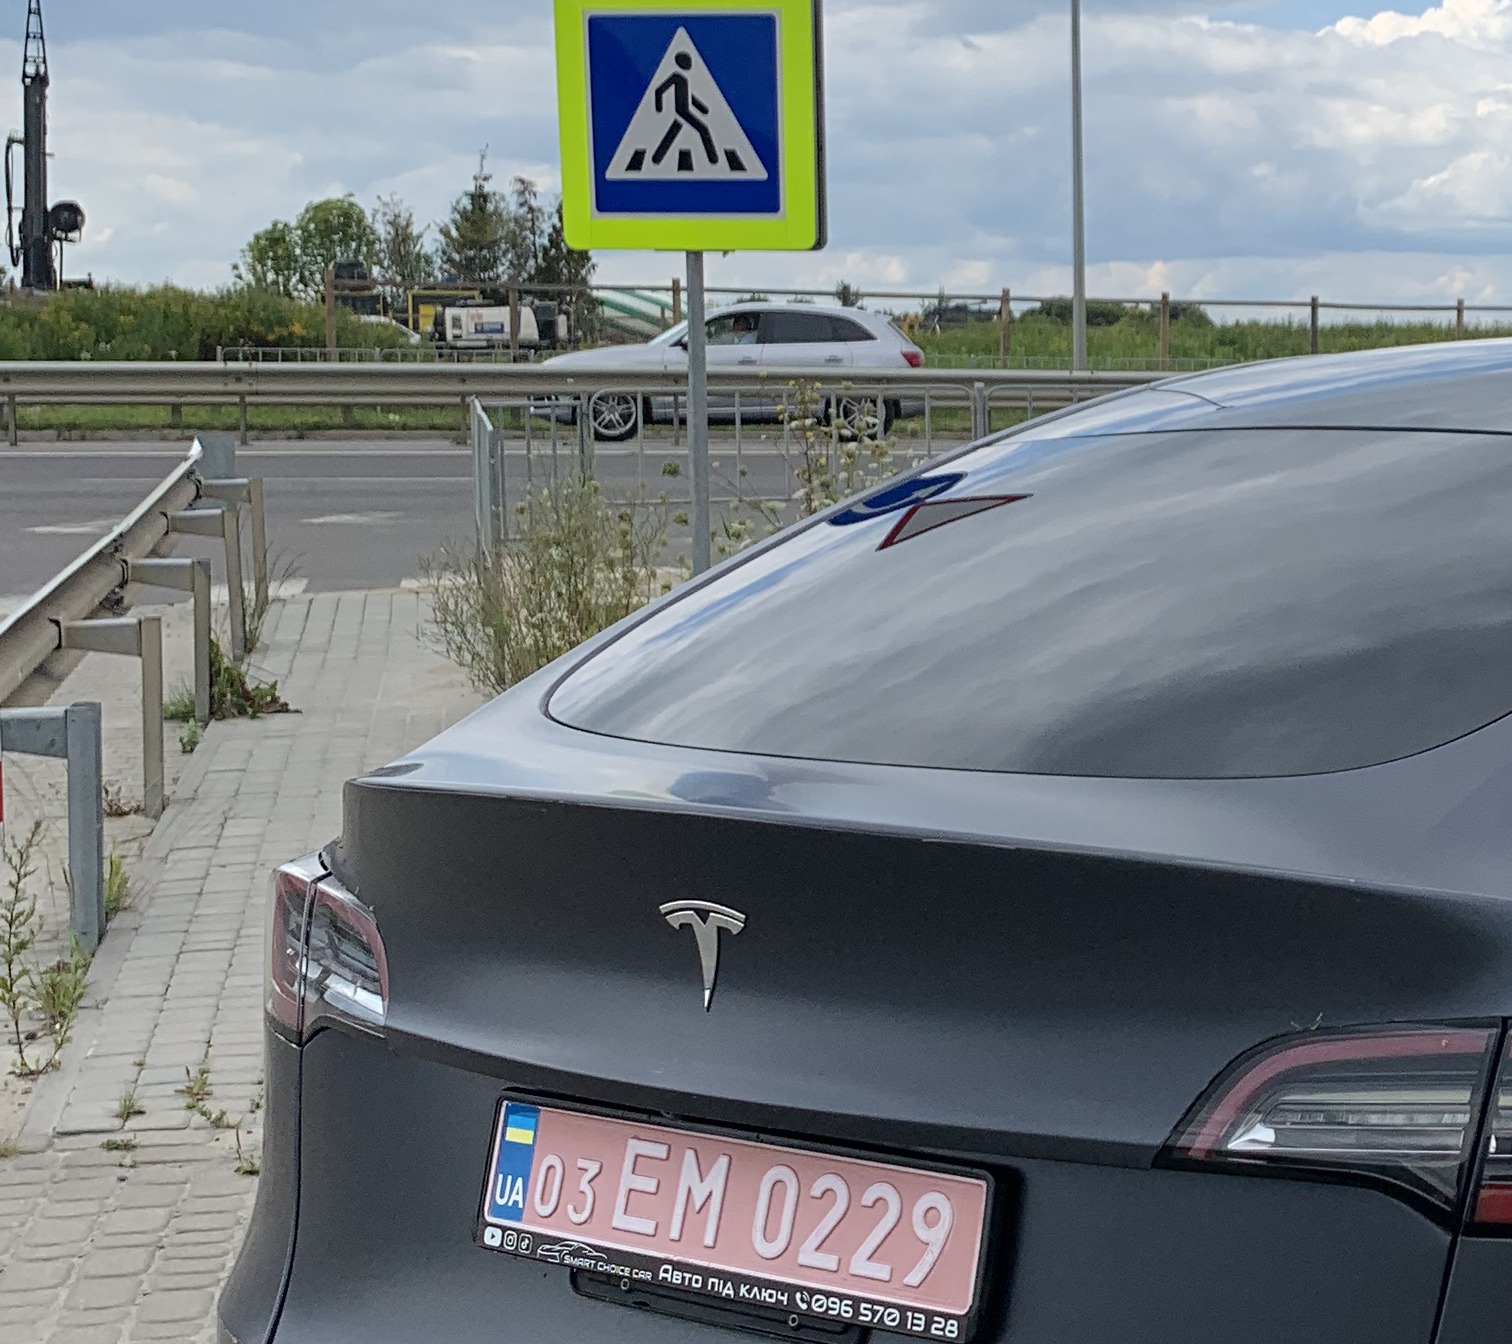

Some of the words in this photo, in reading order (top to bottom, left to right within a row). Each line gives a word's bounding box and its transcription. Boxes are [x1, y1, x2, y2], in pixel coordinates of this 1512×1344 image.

[495, 1173, 524, 1208] UA
[534, 1154, 602, 1226] 03
[611, 1136, 732, 1248] EM
[752, 1164, 954, 1288] 0229
[564, 1255, 597, 1269] SMART
[597, 1262, 631, 1277] CHOICE
[632, 1269, 652, 1281] CAR
[811, 1294, 853, 1318] 096
[858, 1302, 901, 1327] 570
[906, 1311, 925, 1332] 13
[930, 1316, 959, 1338] 28
